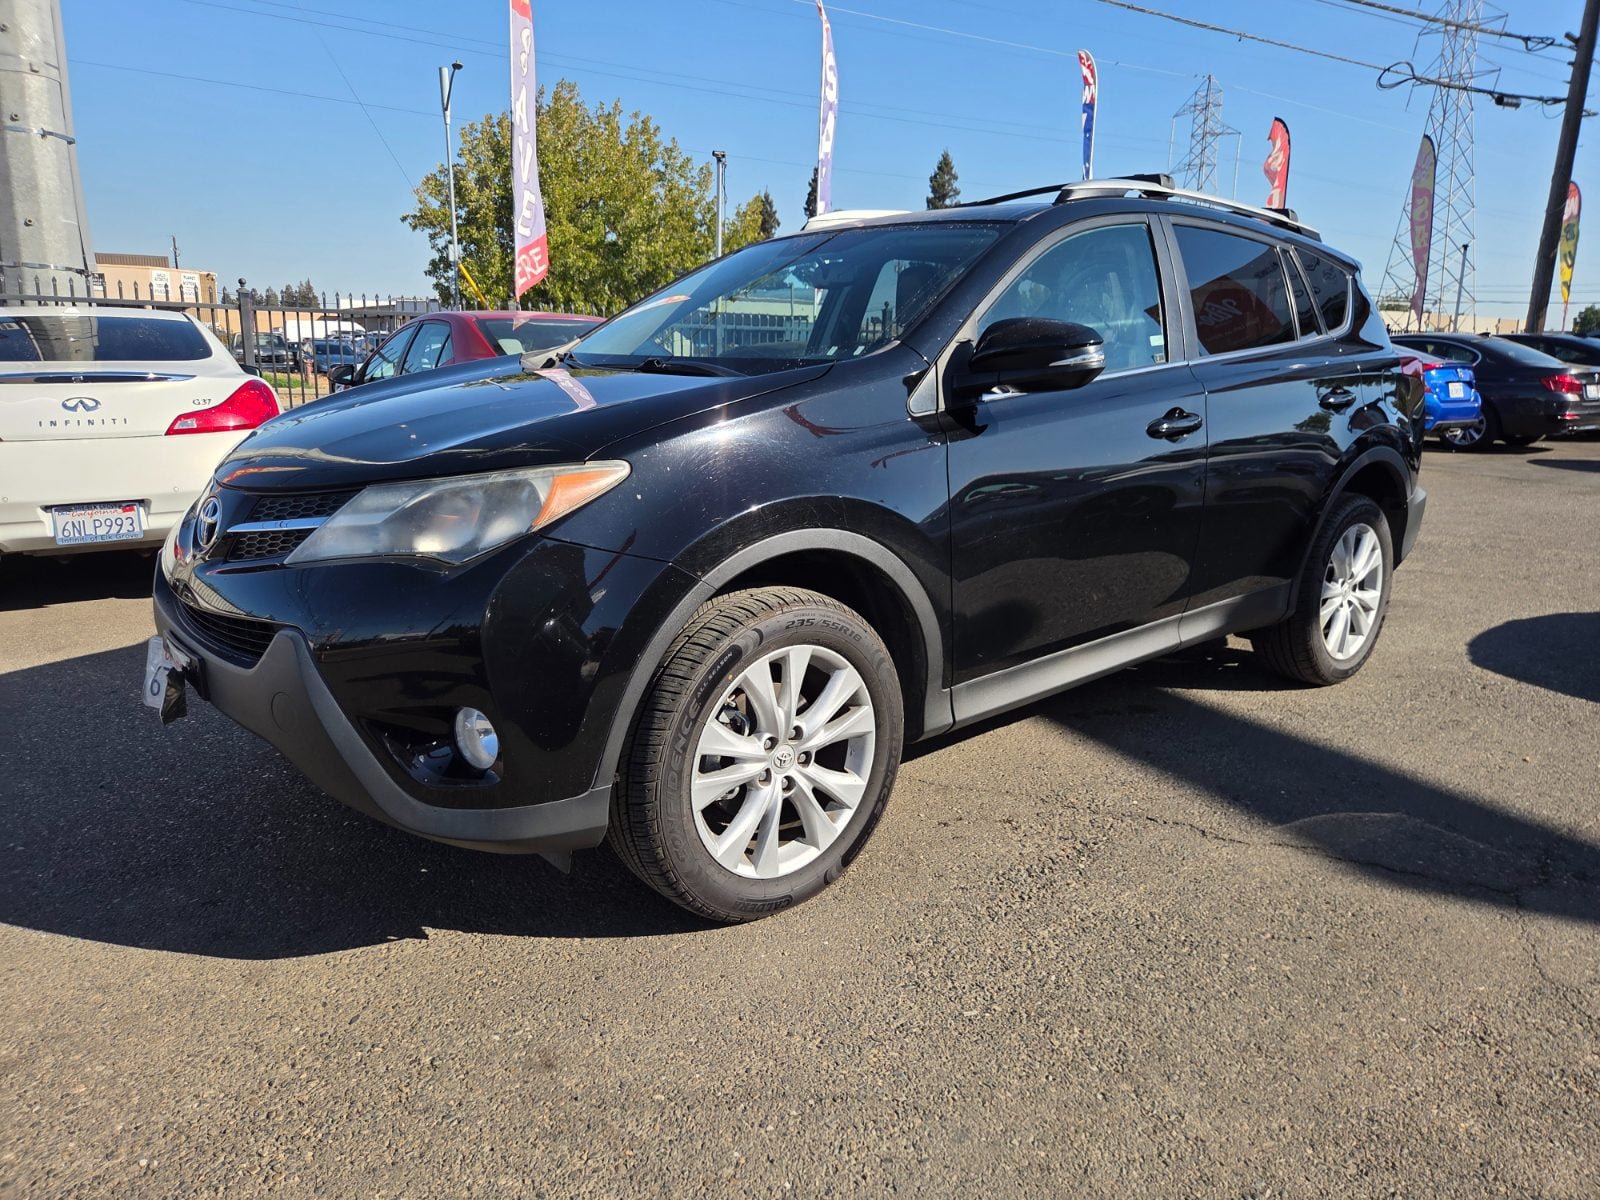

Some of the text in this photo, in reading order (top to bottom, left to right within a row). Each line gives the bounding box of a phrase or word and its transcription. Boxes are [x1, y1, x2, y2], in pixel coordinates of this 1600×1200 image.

[38, 418, 128, 427] INFINITI
[62, 516, 136, 538] 6NLP993
[784, 618, 863, 642] 235/55R18
